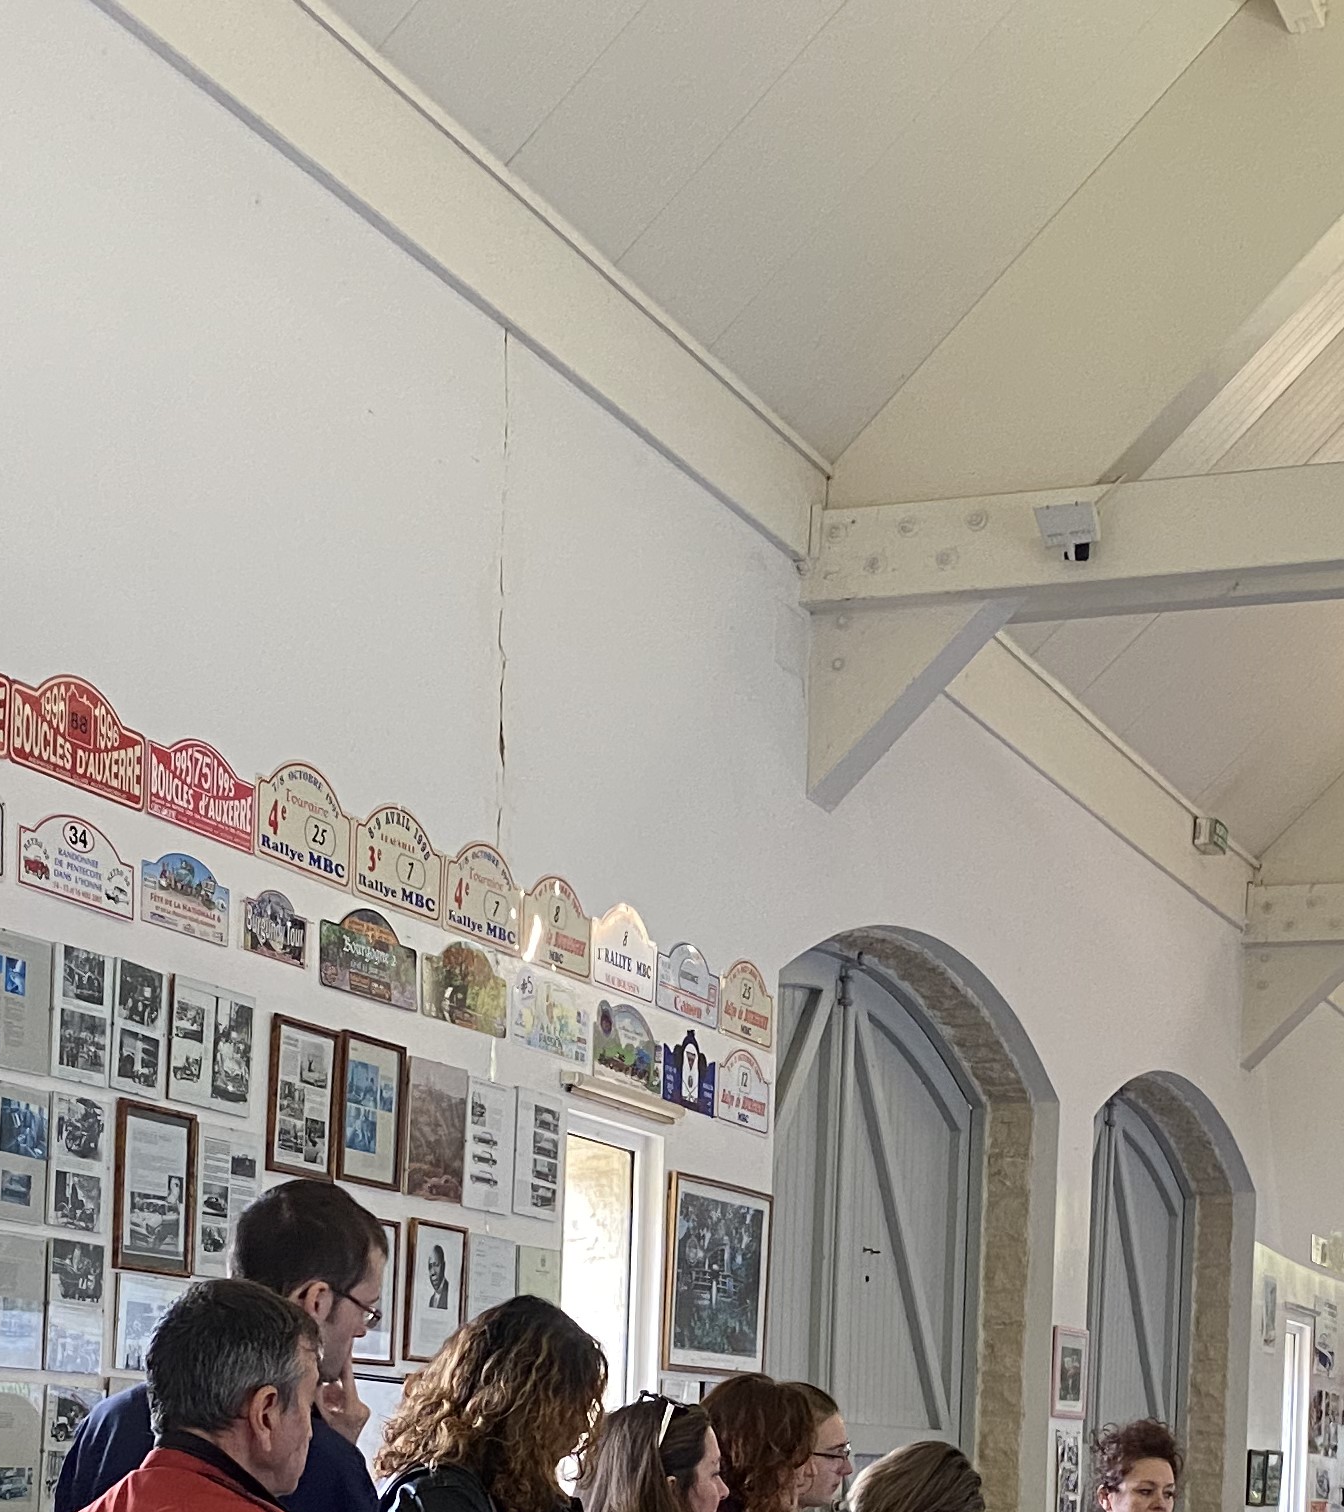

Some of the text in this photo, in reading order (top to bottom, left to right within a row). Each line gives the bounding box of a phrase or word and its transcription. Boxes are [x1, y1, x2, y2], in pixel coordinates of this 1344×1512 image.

[40, 684, 120, 750] 1996 88 1996
[14, 692, 142, 798] BOUCLES D'AUXERRE
[151, 753, 194, 810] BOUCLES
[171, 748, 235, 797] 1995 75 1995
[69, 825, 88, 848] 34
[261, 834, 345, 879] Rallye MBC
[312, 824, 328, 846] 25
[358, 872, 436, 912] Rallye MBC
[448, 909, 516, 945] Rallye MBC
